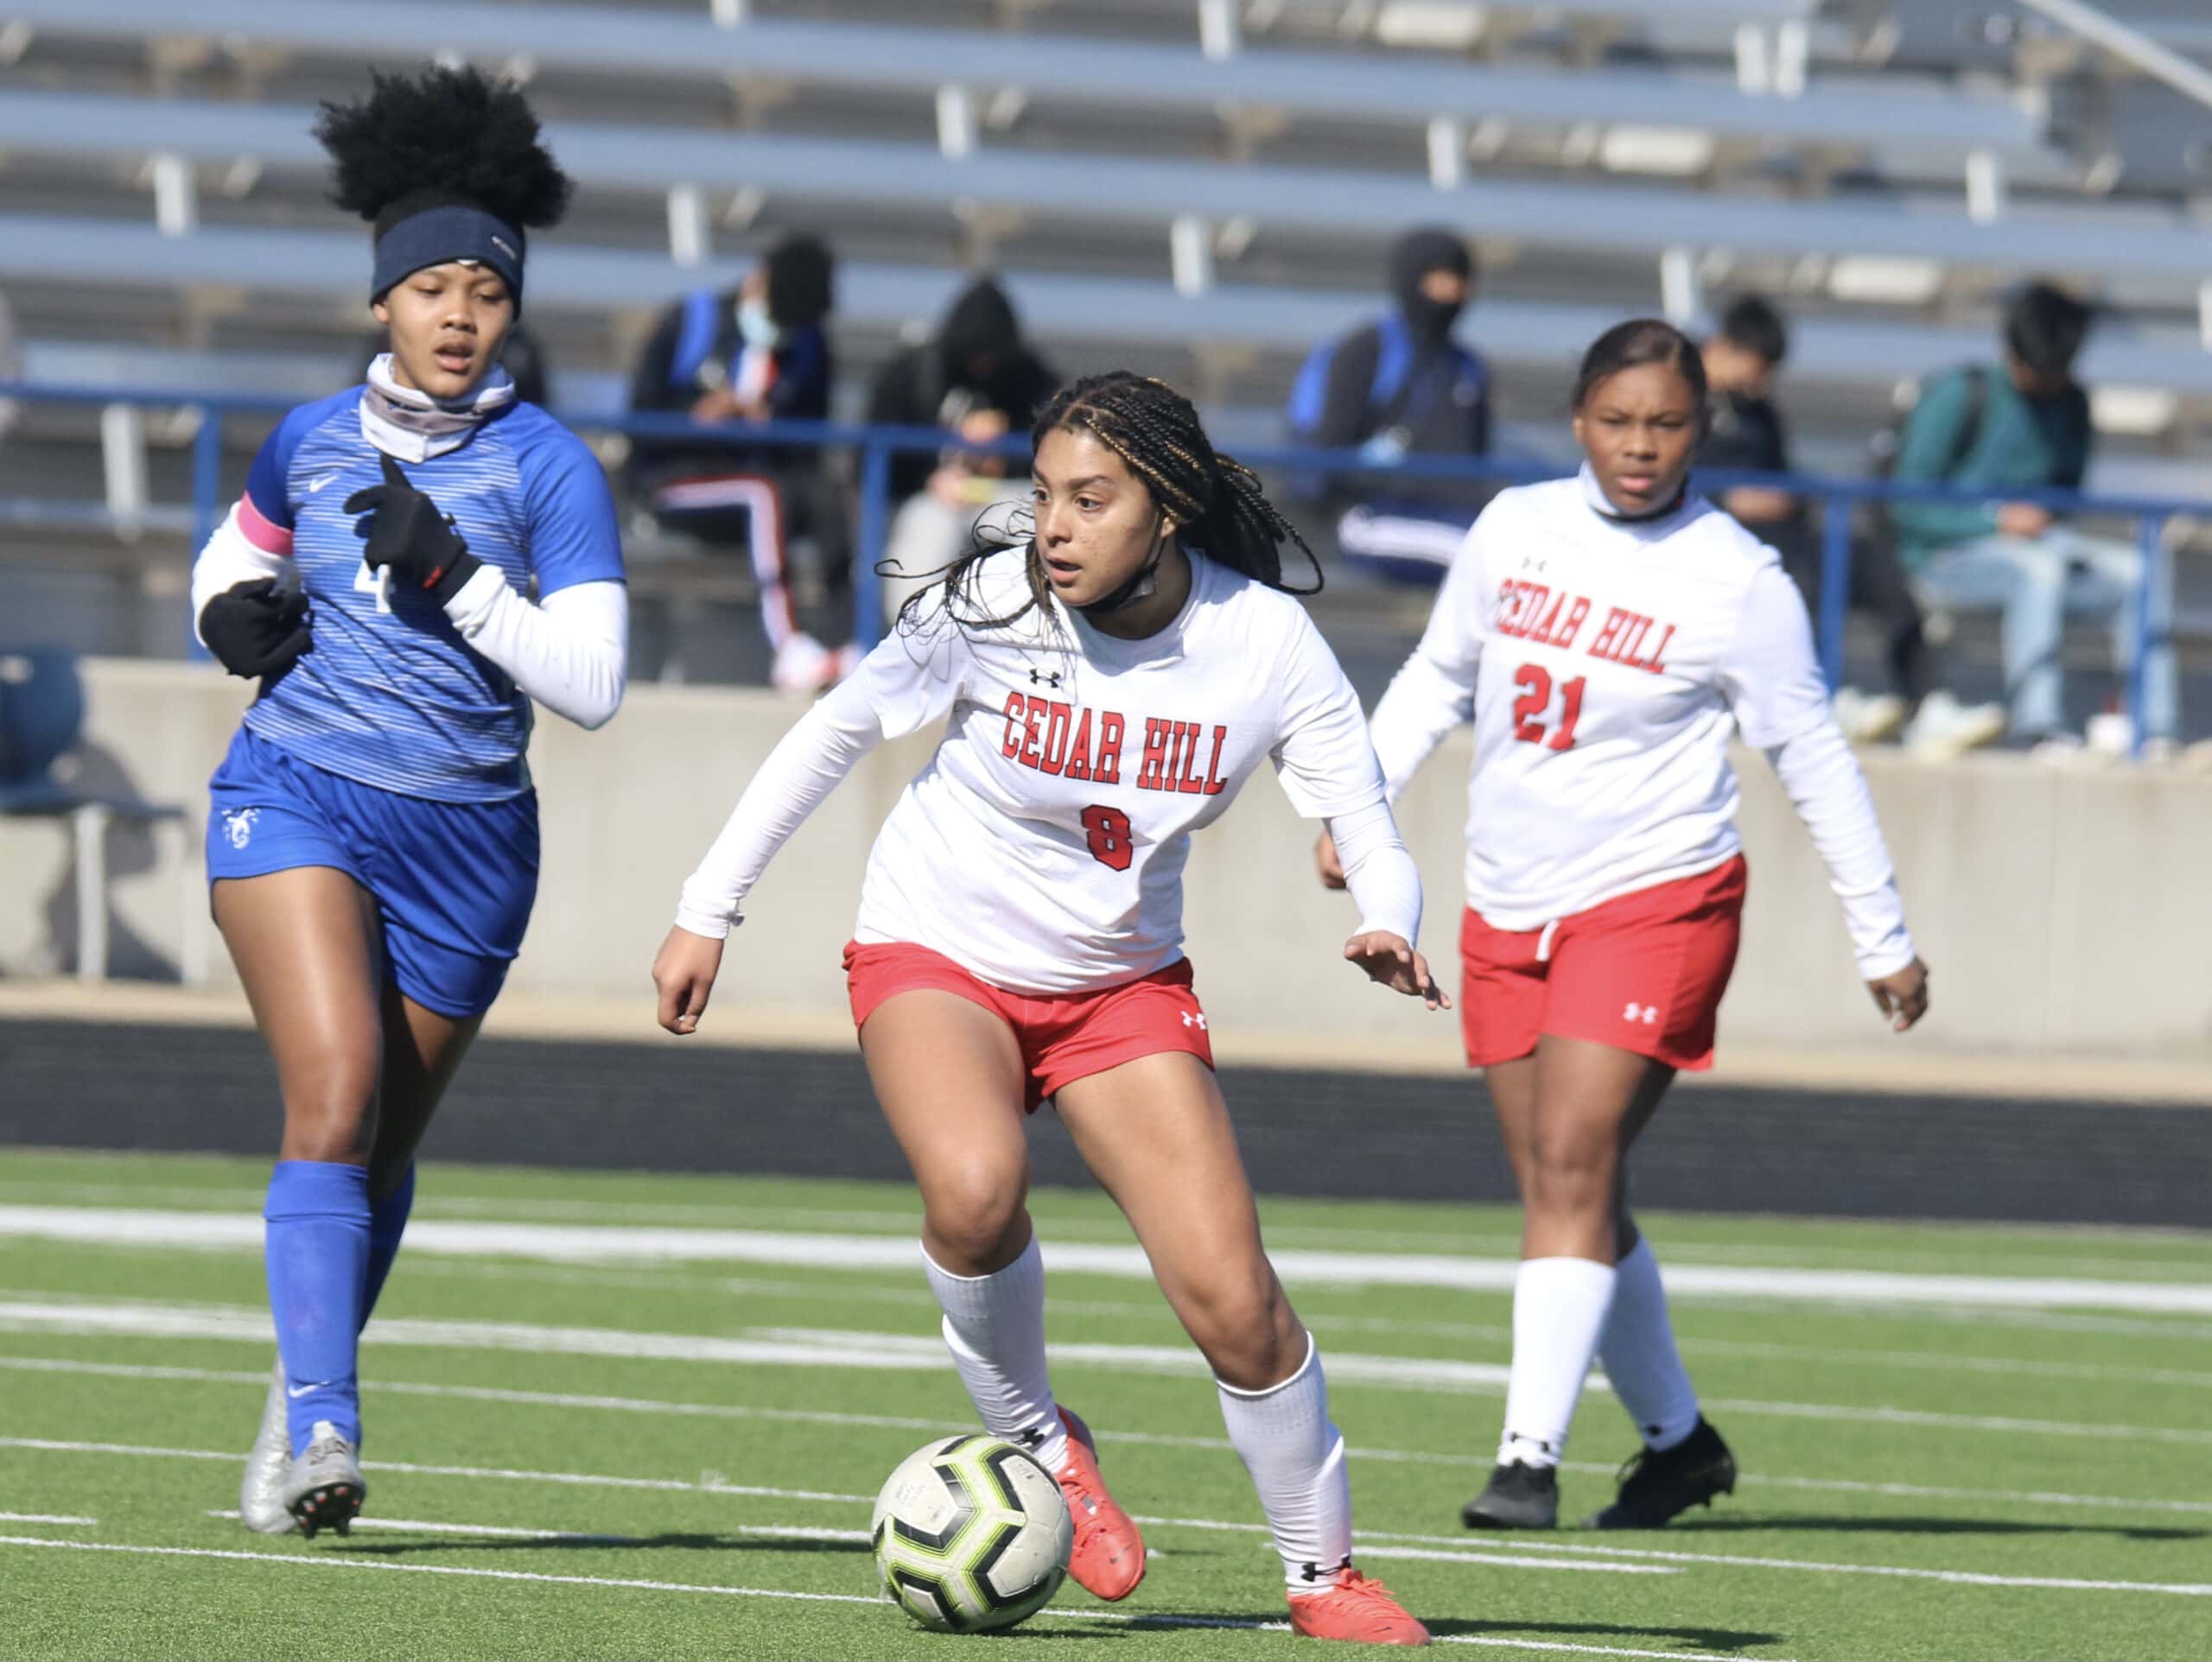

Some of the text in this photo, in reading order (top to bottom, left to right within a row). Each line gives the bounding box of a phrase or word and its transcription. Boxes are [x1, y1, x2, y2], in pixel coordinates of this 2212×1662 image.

[353, 561, 395, 614] 4
[1586, 606, 1676, 675] HILL
[1512, 663, 1586, 752] 21
[1001, 691, 1228, 796] CEDAR HILL
[1081, 804, 1134, 872] 8
